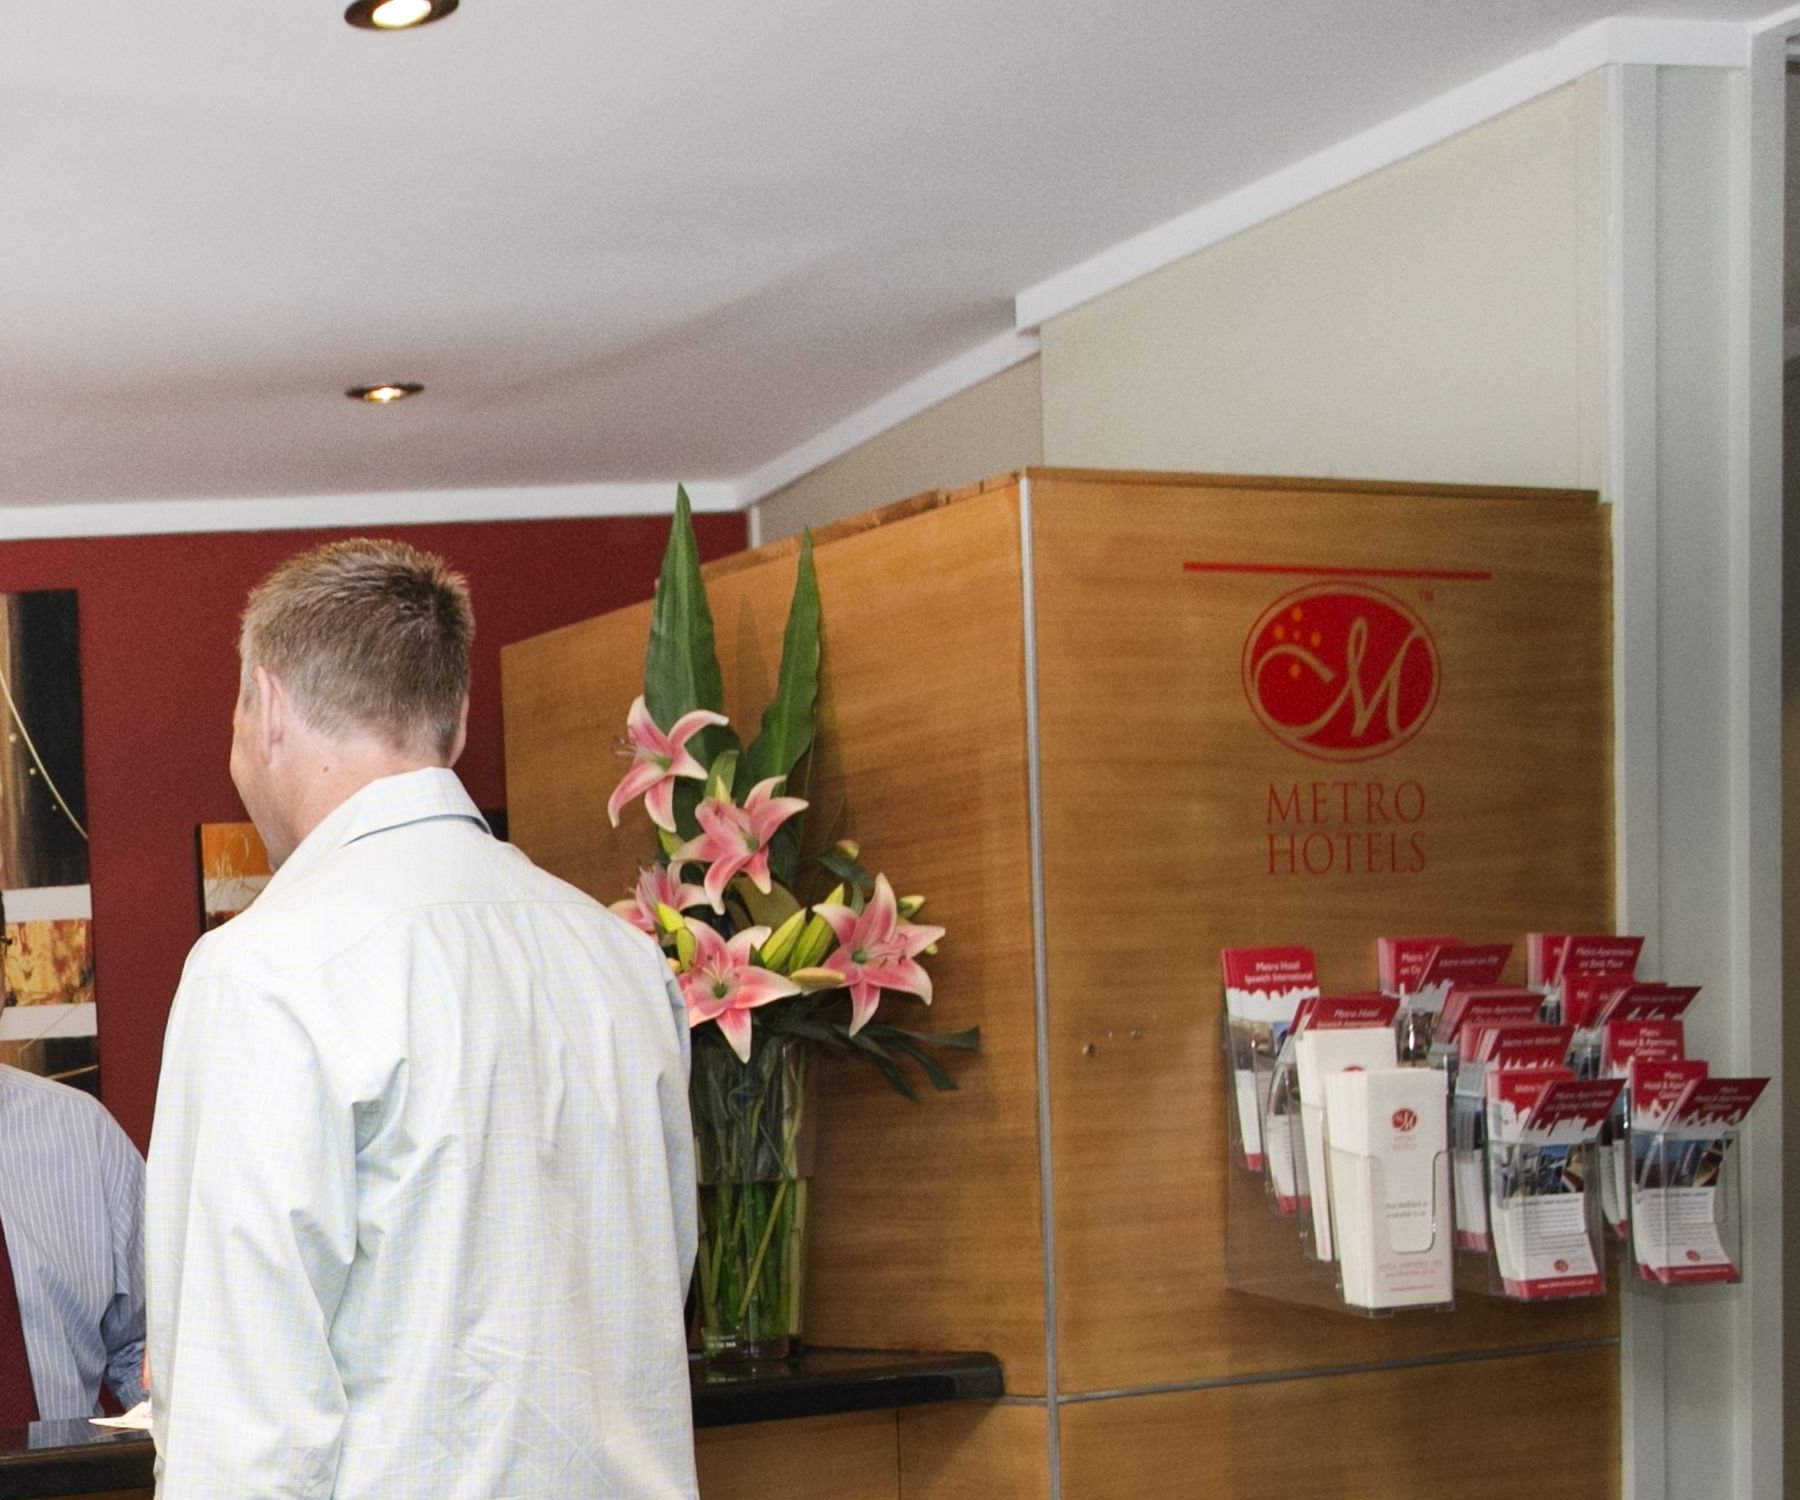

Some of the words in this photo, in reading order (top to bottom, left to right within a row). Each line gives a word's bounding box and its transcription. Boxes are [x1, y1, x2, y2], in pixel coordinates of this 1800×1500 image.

[1267, 780, 1426, 825] METRO
[1267, 831, 1427, 876] HOTELS
[1256, 961, 1279, 972] Metro
[1280, 960, 1300, 970] Hotel
